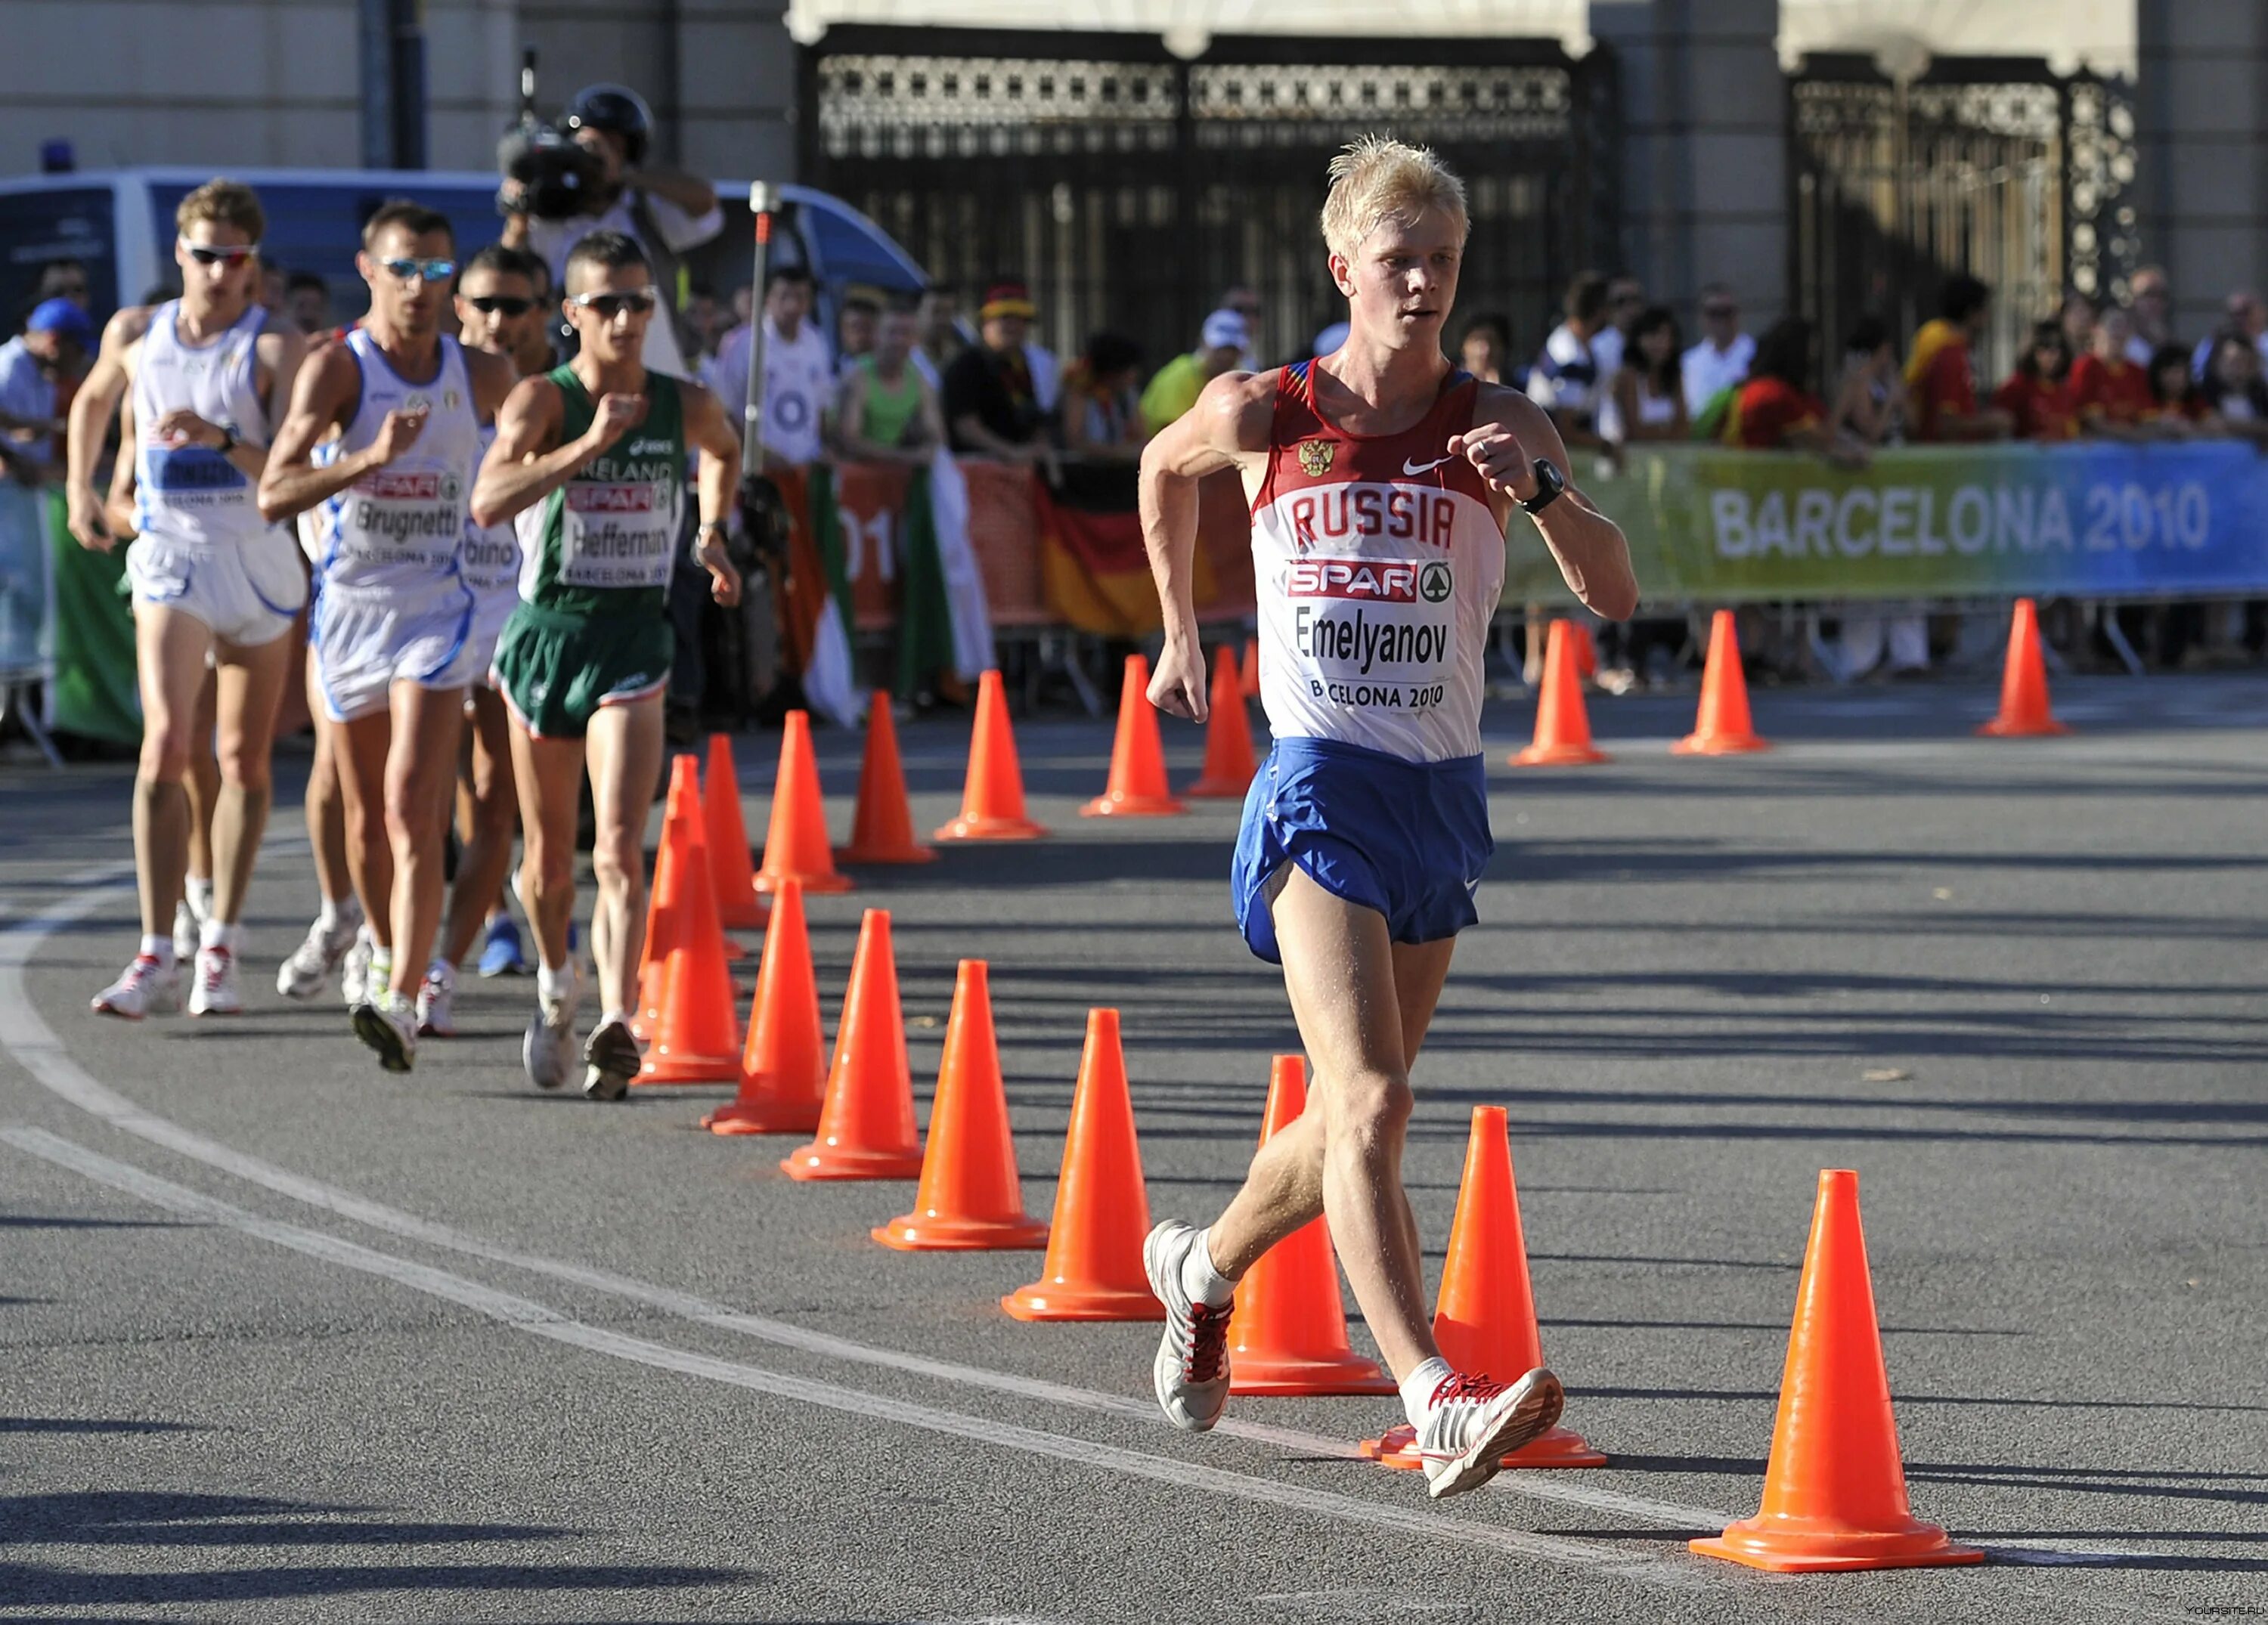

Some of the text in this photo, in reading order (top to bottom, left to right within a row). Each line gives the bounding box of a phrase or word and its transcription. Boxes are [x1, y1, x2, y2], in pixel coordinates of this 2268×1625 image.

[357, 501, 457, 544] Brugnetti
[1292, 489, 1455, 550] RUSSIA
[1711, 481, 2211, 559] BARCELONA 2010
[464, 532, 514, 567] bino
[1290, 563, 1414, 596] SPAR
[1296, 605, 1447, 675] Emelyanov
[1311, 679, 1444, 708] BCELONA 2010
